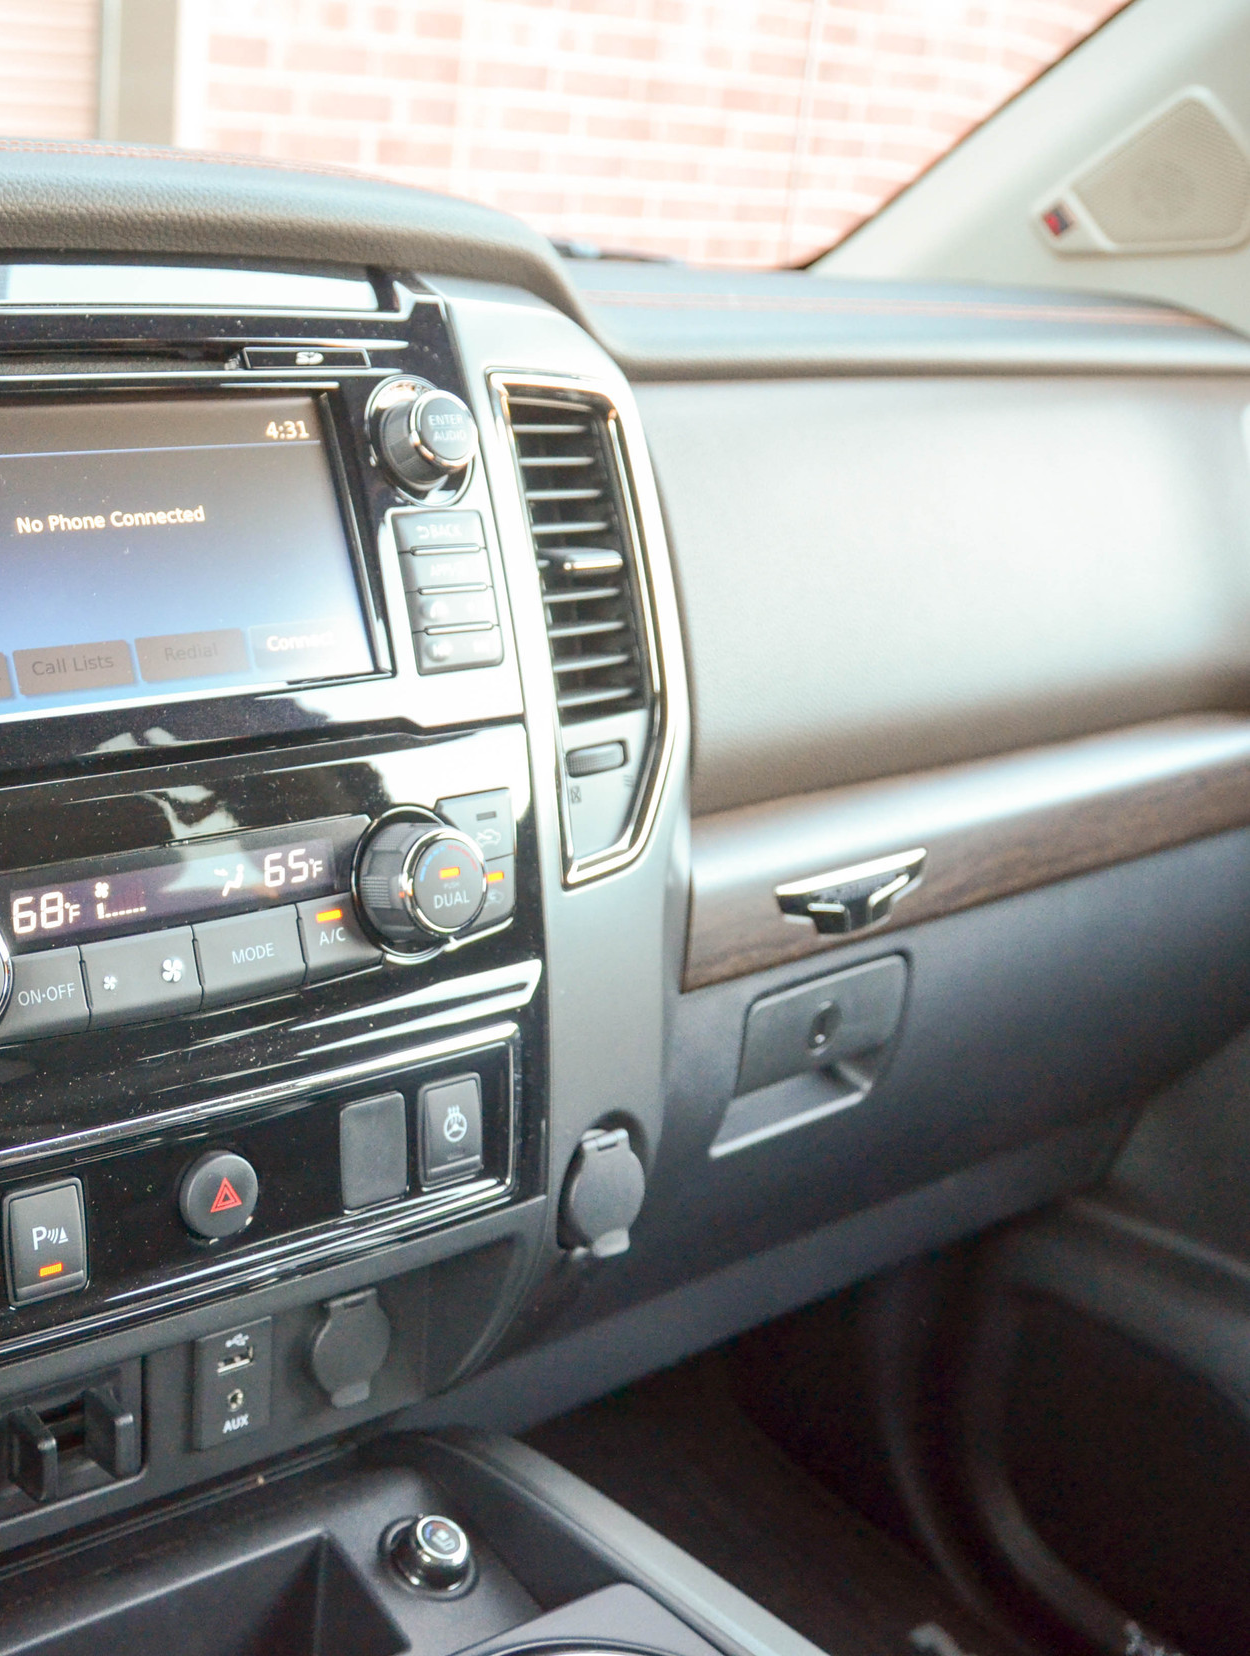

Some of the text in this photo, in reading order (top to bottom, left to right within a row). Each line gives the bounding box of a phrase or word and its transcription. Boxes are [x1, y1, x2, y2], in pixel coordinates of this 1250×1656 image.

[265, 420, 309, 440] 4:31
[428, 414, 463, 426] ENTER
[433, 429, 467, 442] AUDIO
[16, 504, 206, 534] No Phone Connected
[164, 642, 219, 663] Redial
[31, 653, 115, 676] Call Lists
[433, 891, 470, 909] DUAL
[319, 927, 347, 947] A/C
[232, 942, 275, 965] MODE
[32, 1226, 48, 1251] P
[222, 1414, 250, 1435] AUX
